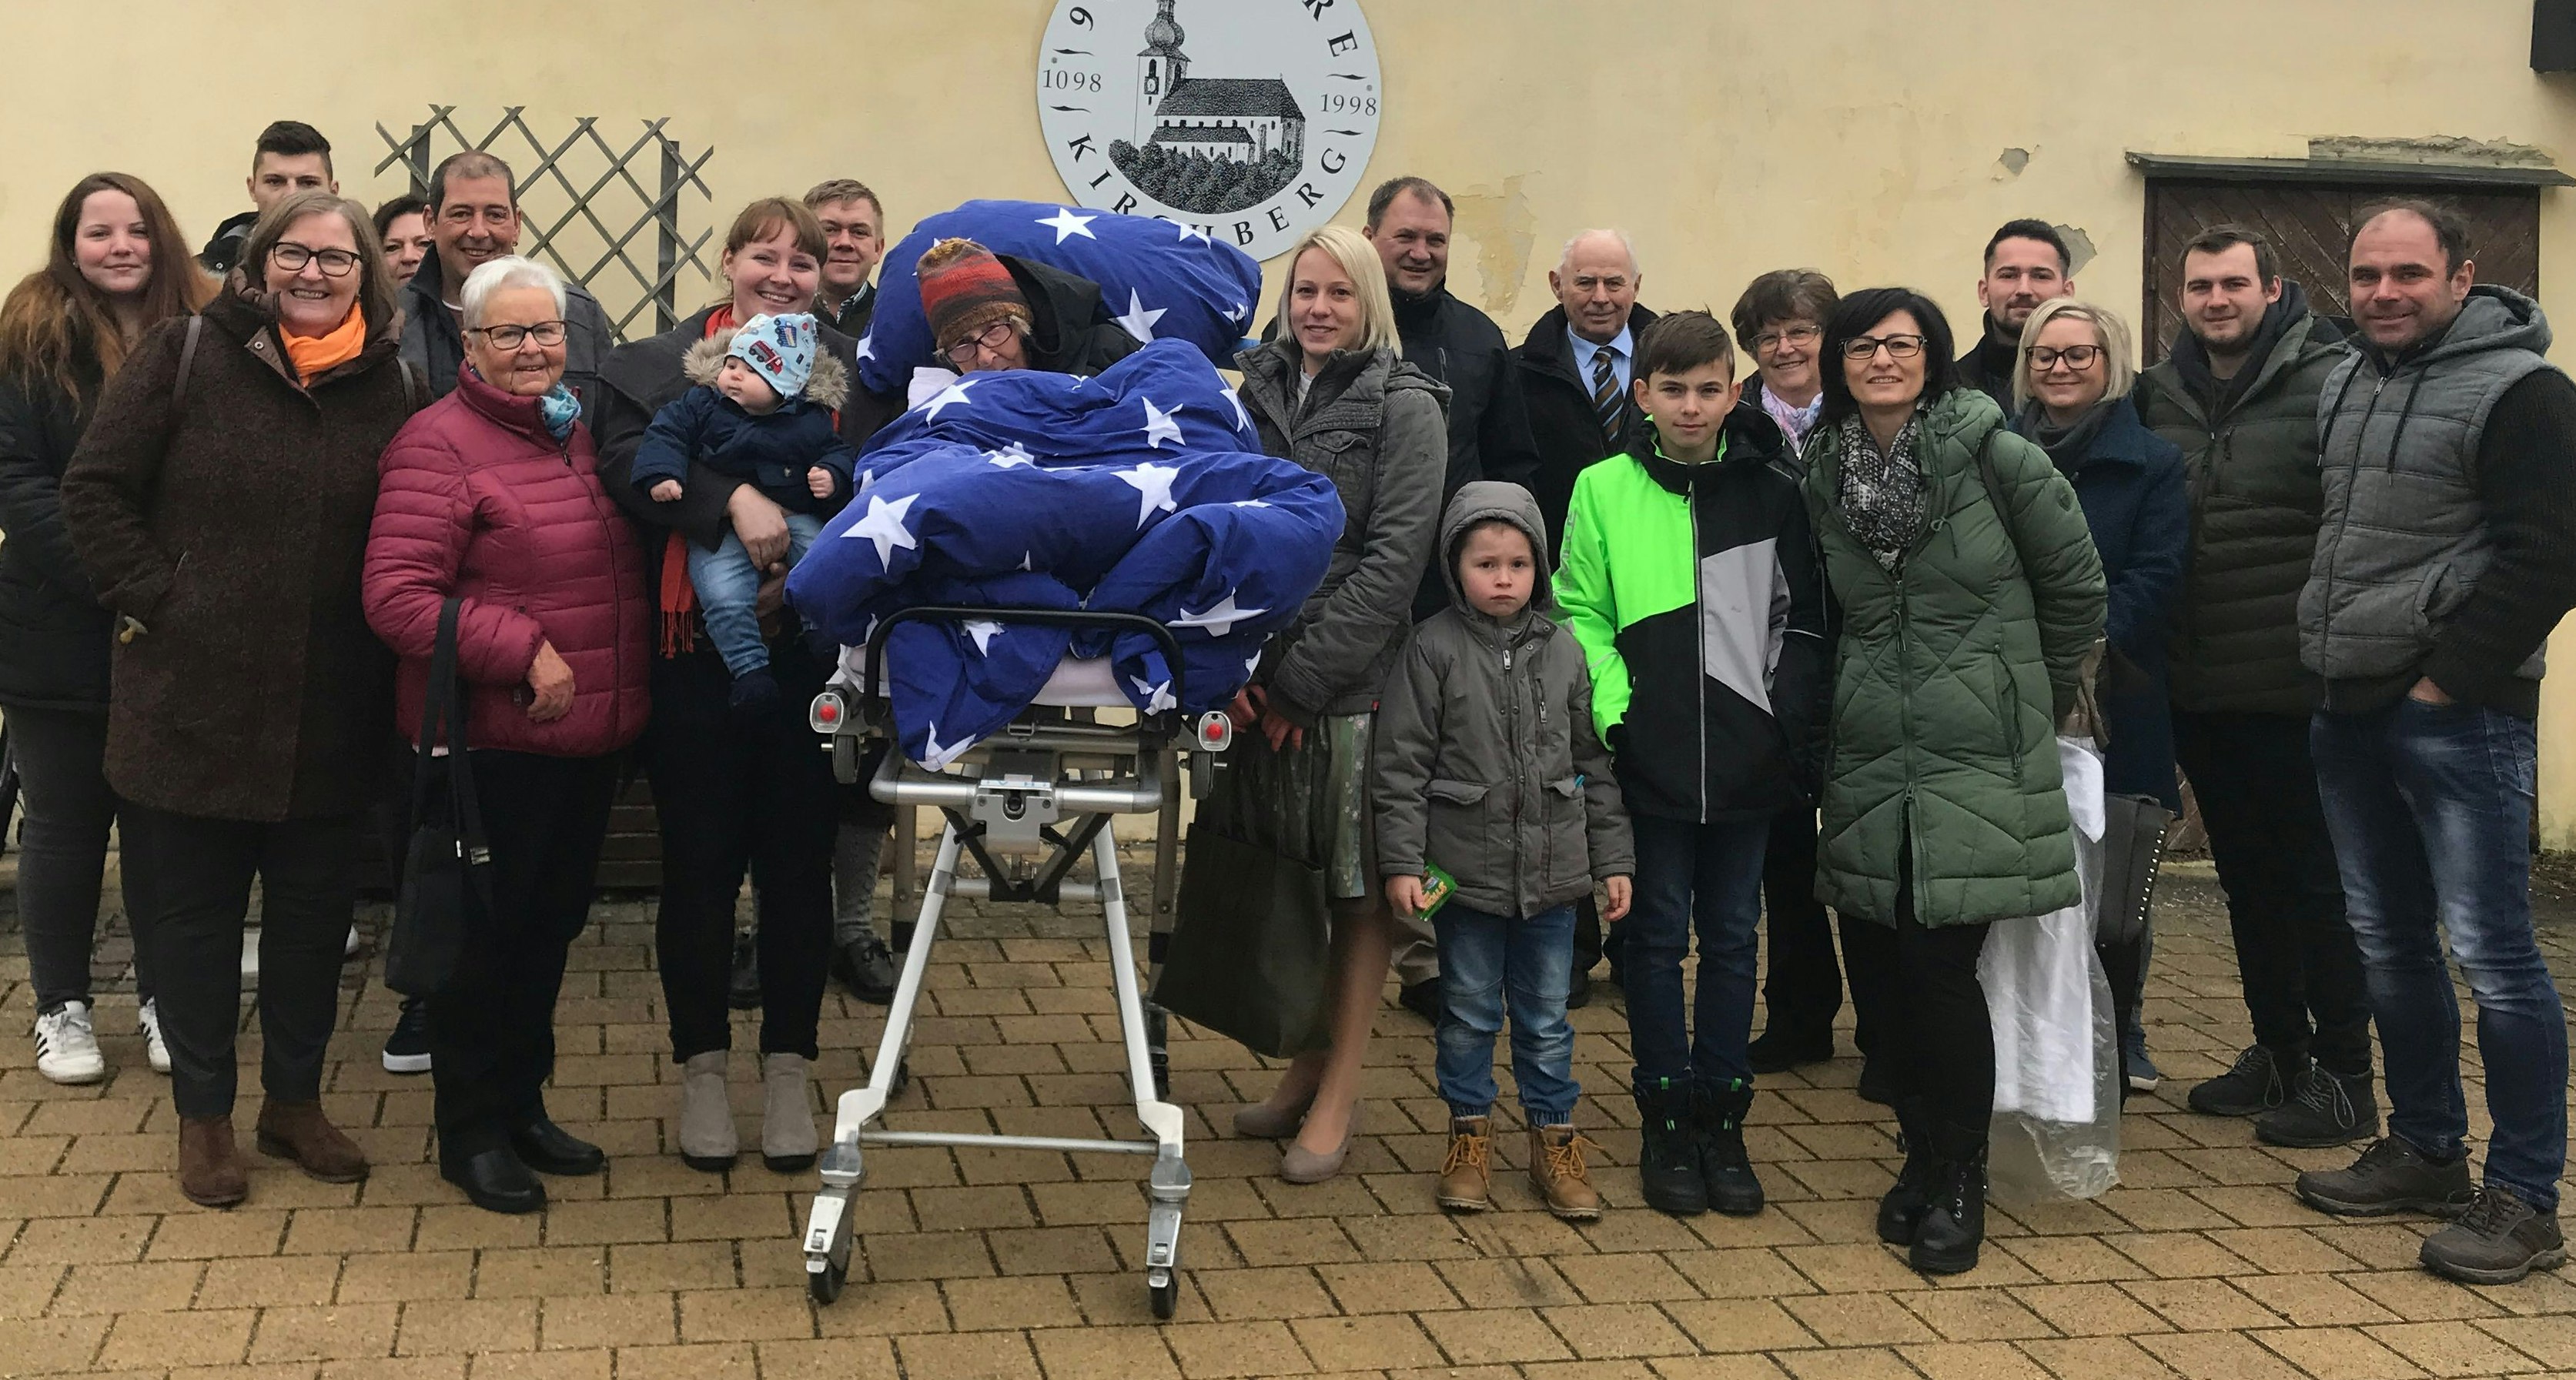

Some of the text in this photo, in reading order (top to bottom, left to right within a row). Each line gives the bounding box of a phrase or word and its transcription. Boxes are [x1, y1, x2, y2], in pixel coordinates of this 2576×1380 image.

[1069, 0, 1358, 58] 9 RE
[1042, 69, 1102, 93] 1098
[1320, 92, 1377, 117] 1998
[1067, 132, 1347, 246] KIRBERG
